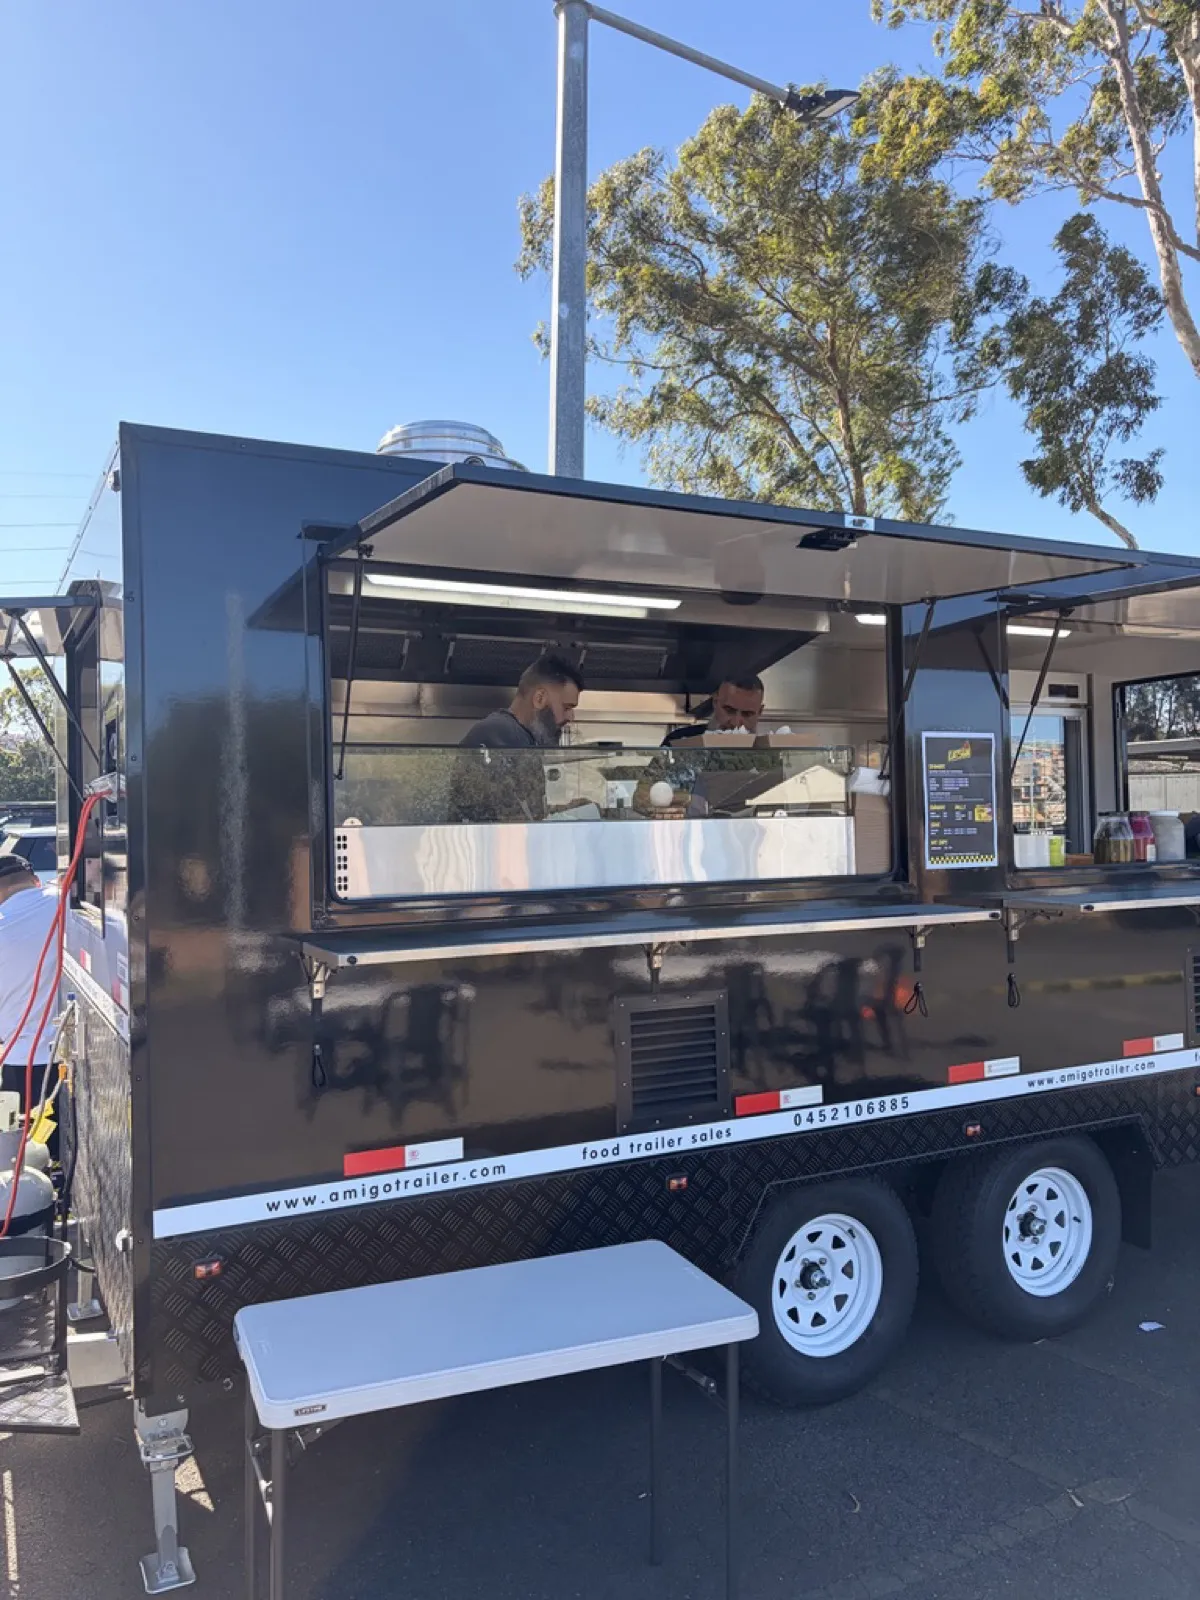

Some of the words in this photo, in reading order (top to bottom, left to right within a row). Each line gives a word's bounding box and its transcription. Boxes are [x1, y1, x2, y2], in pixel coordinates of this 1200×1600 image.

[1027, 1060, 1156, 1088] www.amigotrailer.com
[793, 1096, 910, 1127] 0452106885
[582, 1143, 620, 1161] food
[629, 1134, 683, 1154] trailer
[691, 1126, 732, 1144] sales
[266, 1162, 507, 1212] www.amigotrailer.com
